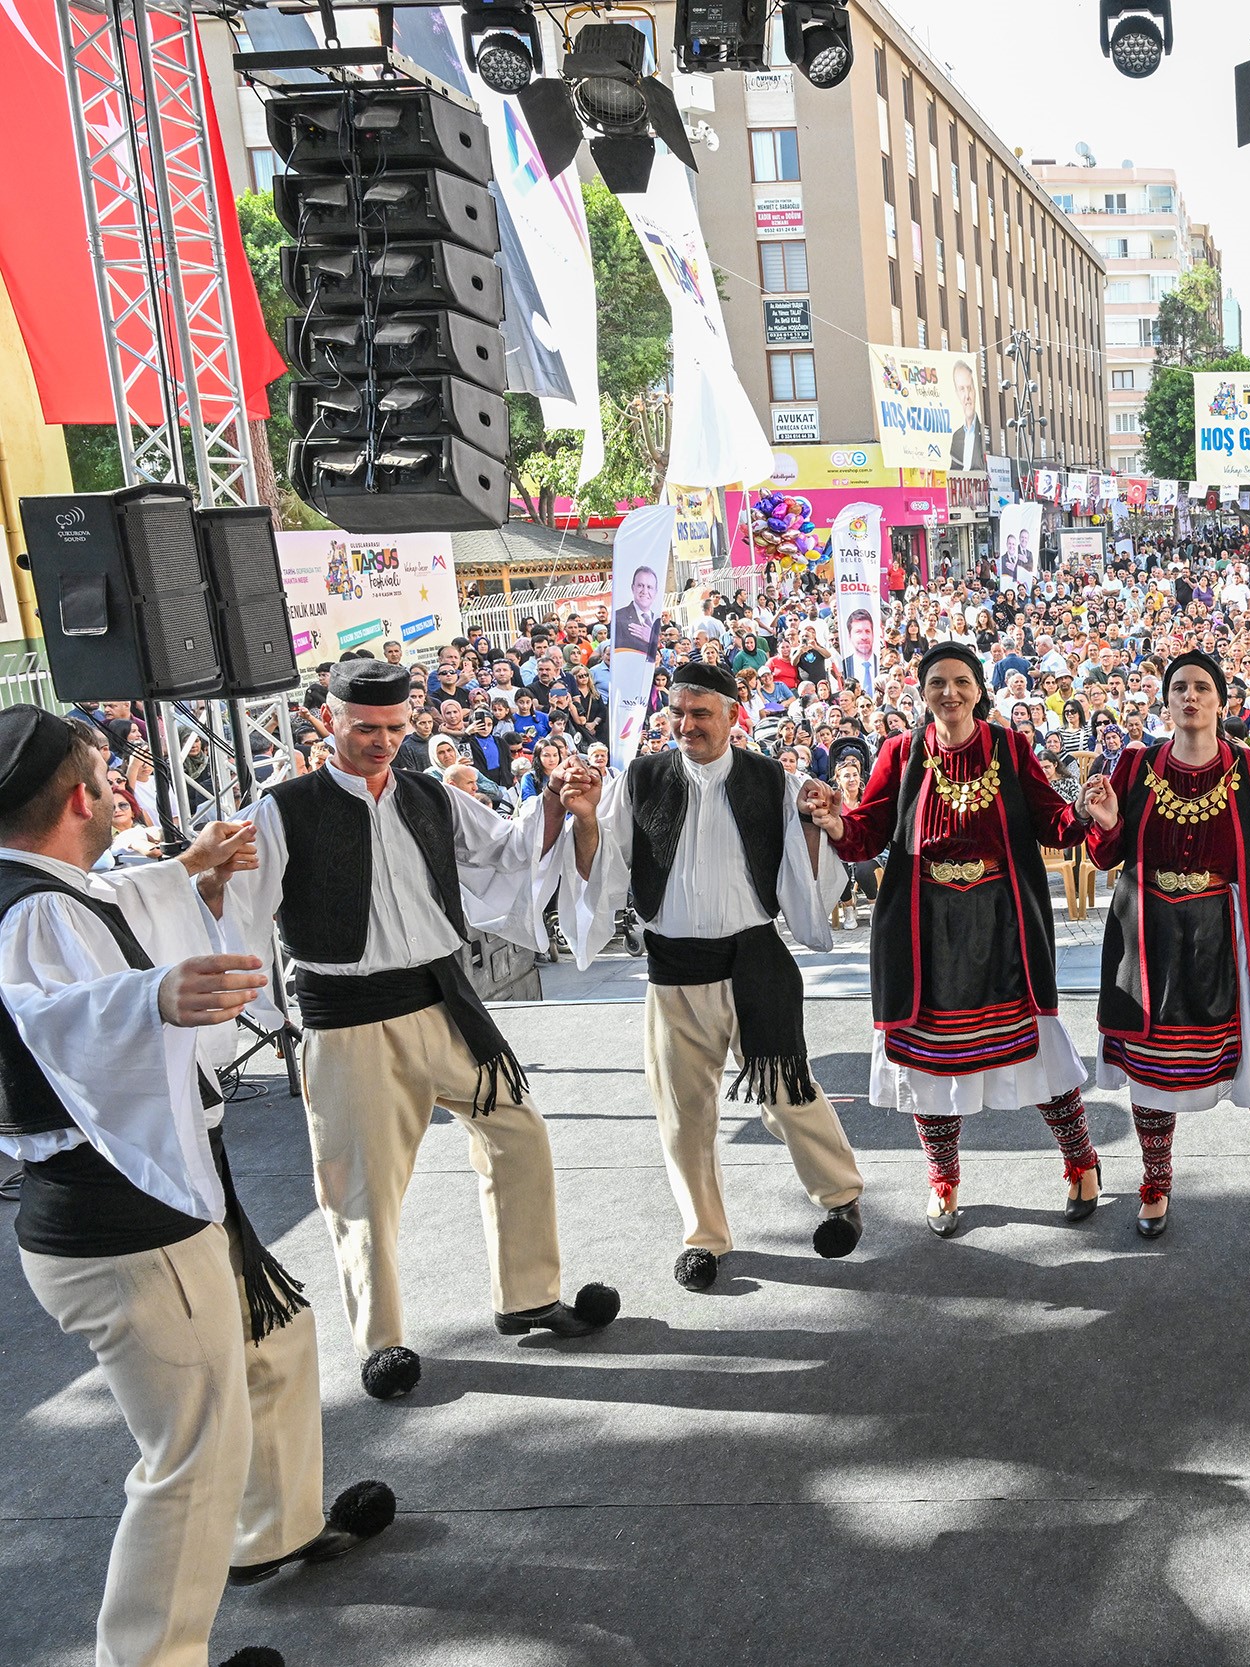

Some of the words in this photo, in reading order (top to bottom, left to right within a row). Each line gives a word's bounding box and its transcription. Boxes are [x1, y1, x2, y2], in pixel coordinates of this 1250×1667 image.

[900, 364, 938, 385] TARSUS
[777, 413, 814, 423] AVUKAT
[881, 400, 906, 435] HOŞ
[1200, 427, 1235, 457] HOŞ
[832, 450, 867, 466] eve
[351, 548, 399, 574] TARSUS
[839, 548, 877, 559] TARSUS
[369, 571, 400, 589] Festivali
[309, 602, 328, 616] ALANI
